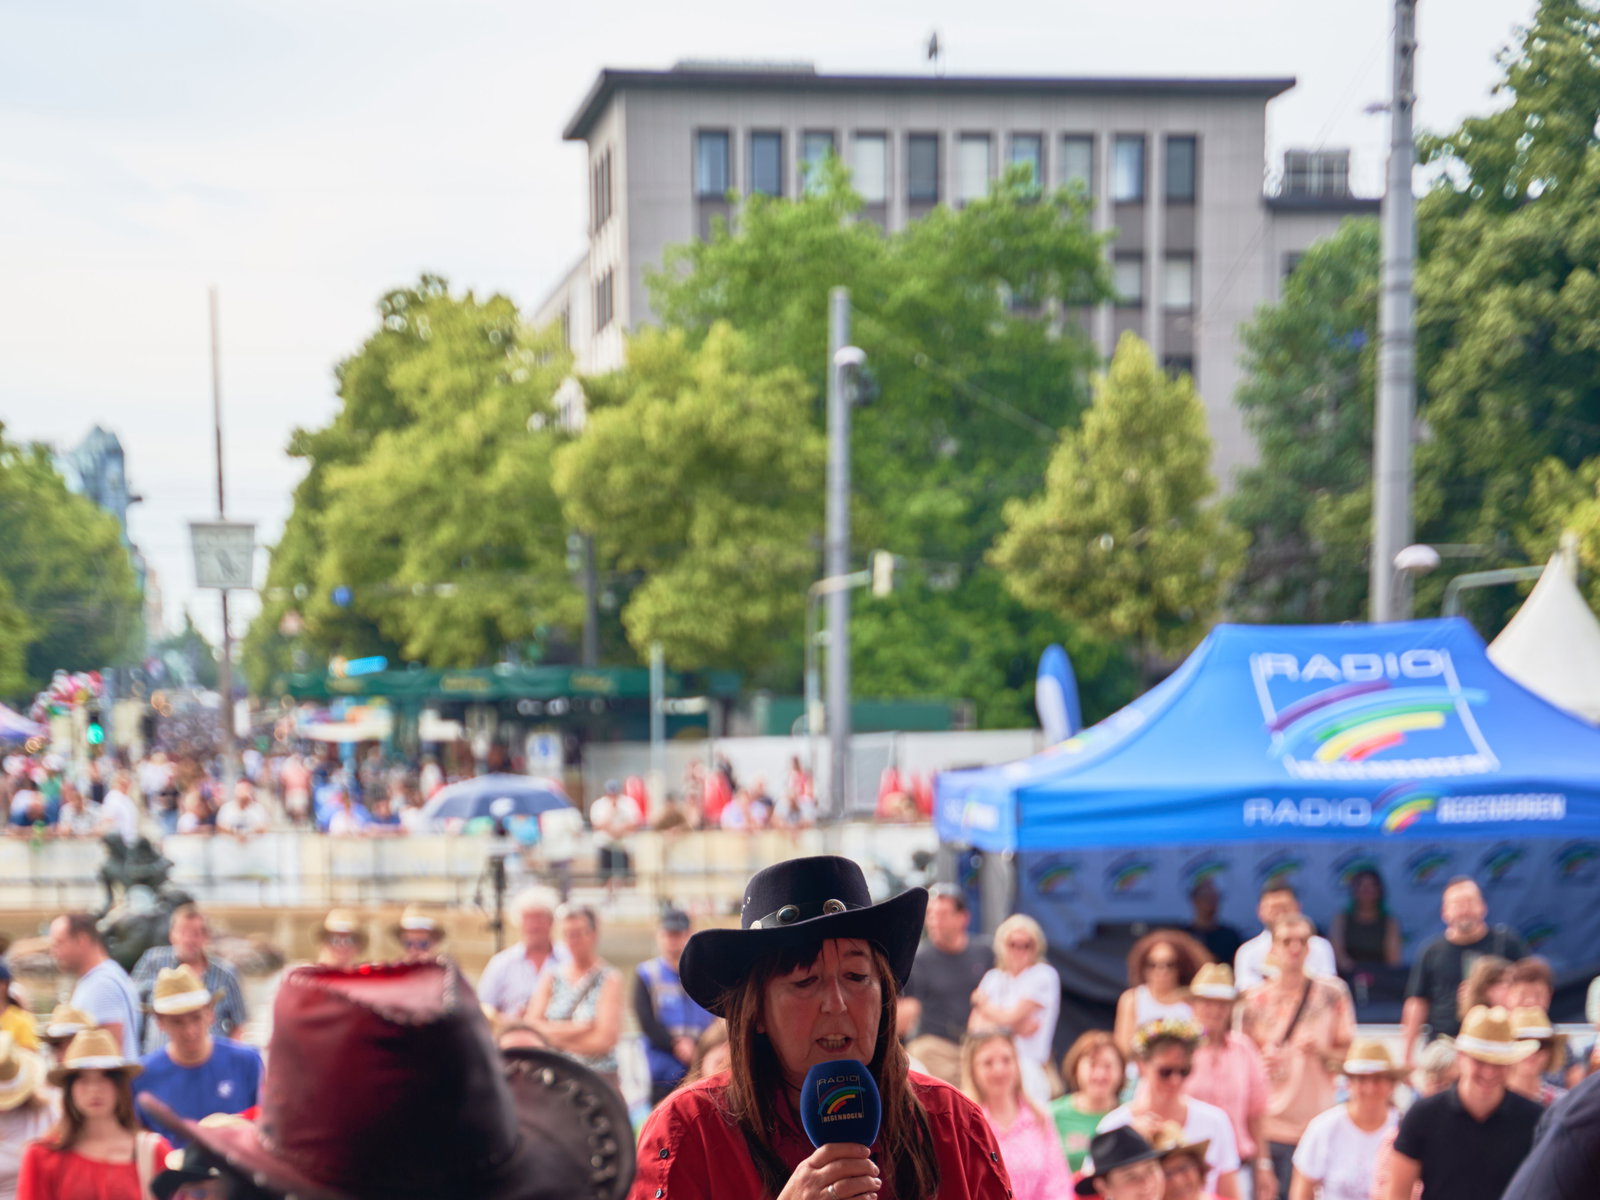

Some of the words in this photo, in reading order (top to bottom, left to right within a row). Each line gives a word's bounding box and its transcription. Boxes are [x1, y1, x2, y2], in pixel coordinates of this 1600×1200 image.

[1259, 648, 1443, 682] RADIO
[1243, 797, 1373, 828] RADIO
[818, 1075, 858, 1085] RADIO
